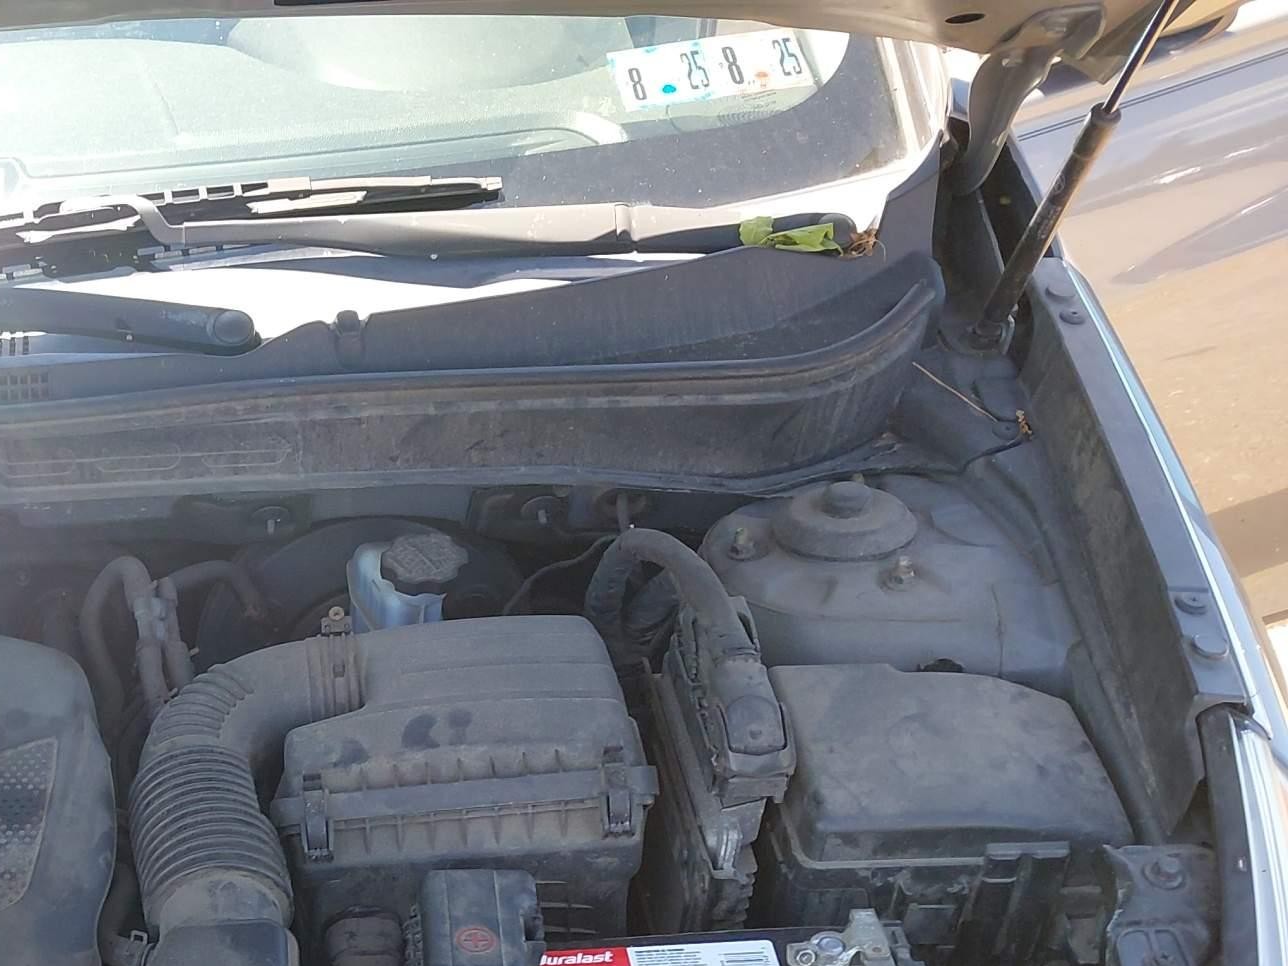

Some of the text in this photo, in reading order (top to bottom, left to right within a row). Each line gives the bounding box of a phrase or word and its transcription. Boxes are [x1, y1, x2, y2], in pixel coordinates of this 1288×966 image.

[627, 50, 710, 101] 8 25
[721, 37, 803, 85] 8 25
